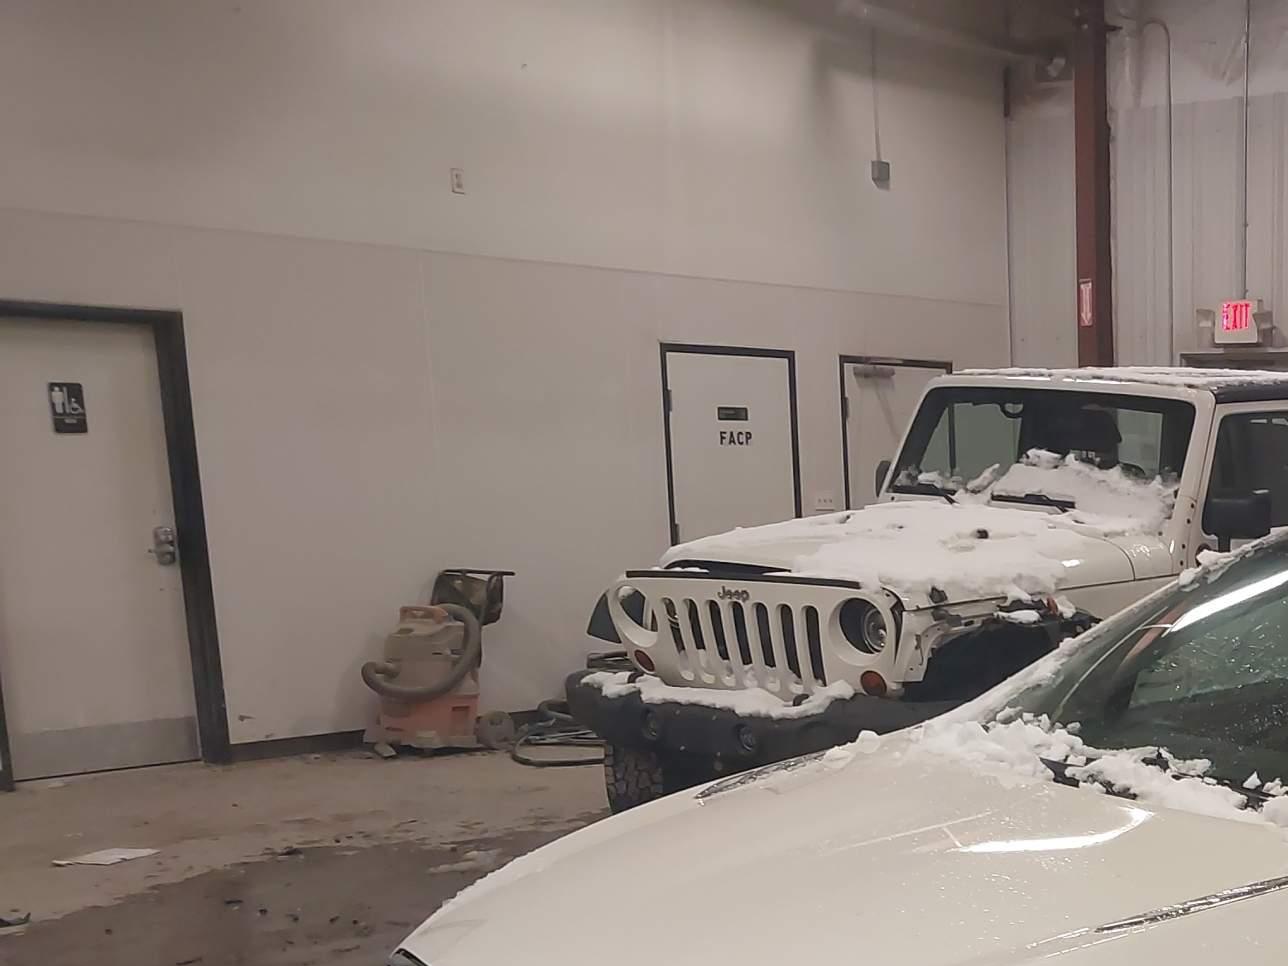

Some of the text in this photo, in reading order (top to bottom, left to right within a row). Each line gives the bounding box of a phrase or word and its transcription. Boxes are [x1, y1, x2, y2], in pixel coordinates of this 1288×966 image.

[1222, 303, 1251, 330] EXIT
[719, 430, 753, 446] FACP
[717, 585, 750, 603] Jeep
